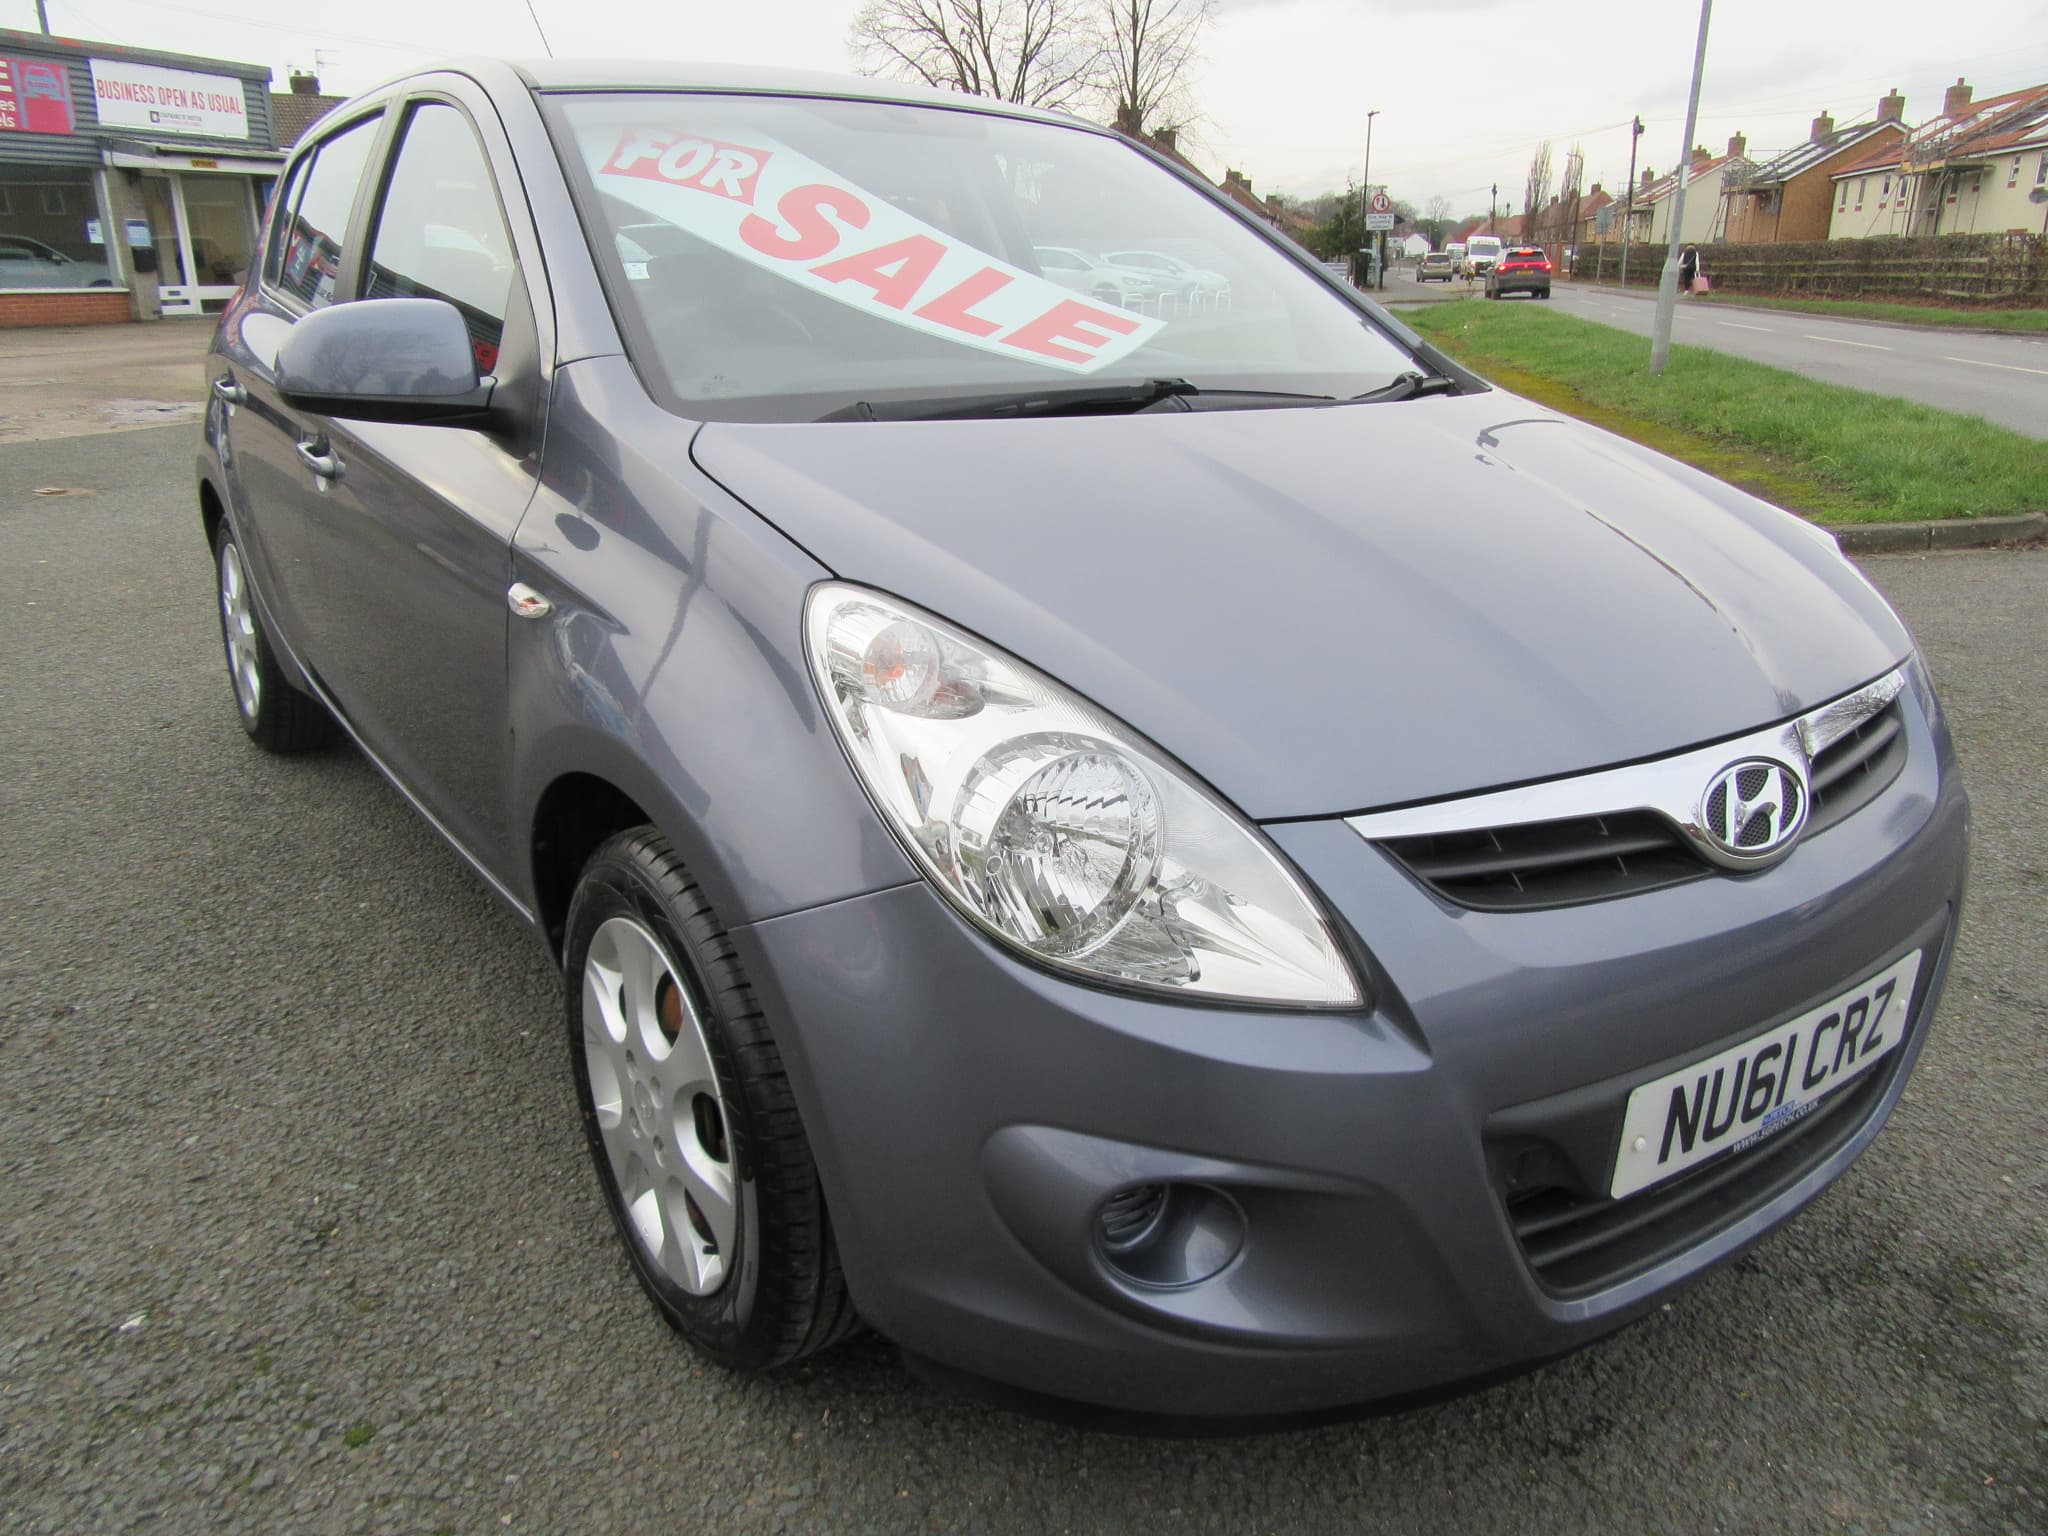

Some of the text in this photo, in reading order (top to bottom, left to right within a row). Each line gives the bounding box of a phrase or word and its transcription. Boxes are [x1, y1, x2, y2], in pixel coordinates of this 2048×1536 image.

[96, 79, 242, 115] BUSINESS OPEN AS USUAL
[613, 127, 1139, 363] FOR SALE
[1657, 976, 1898, 1165] NU61 CRZ
